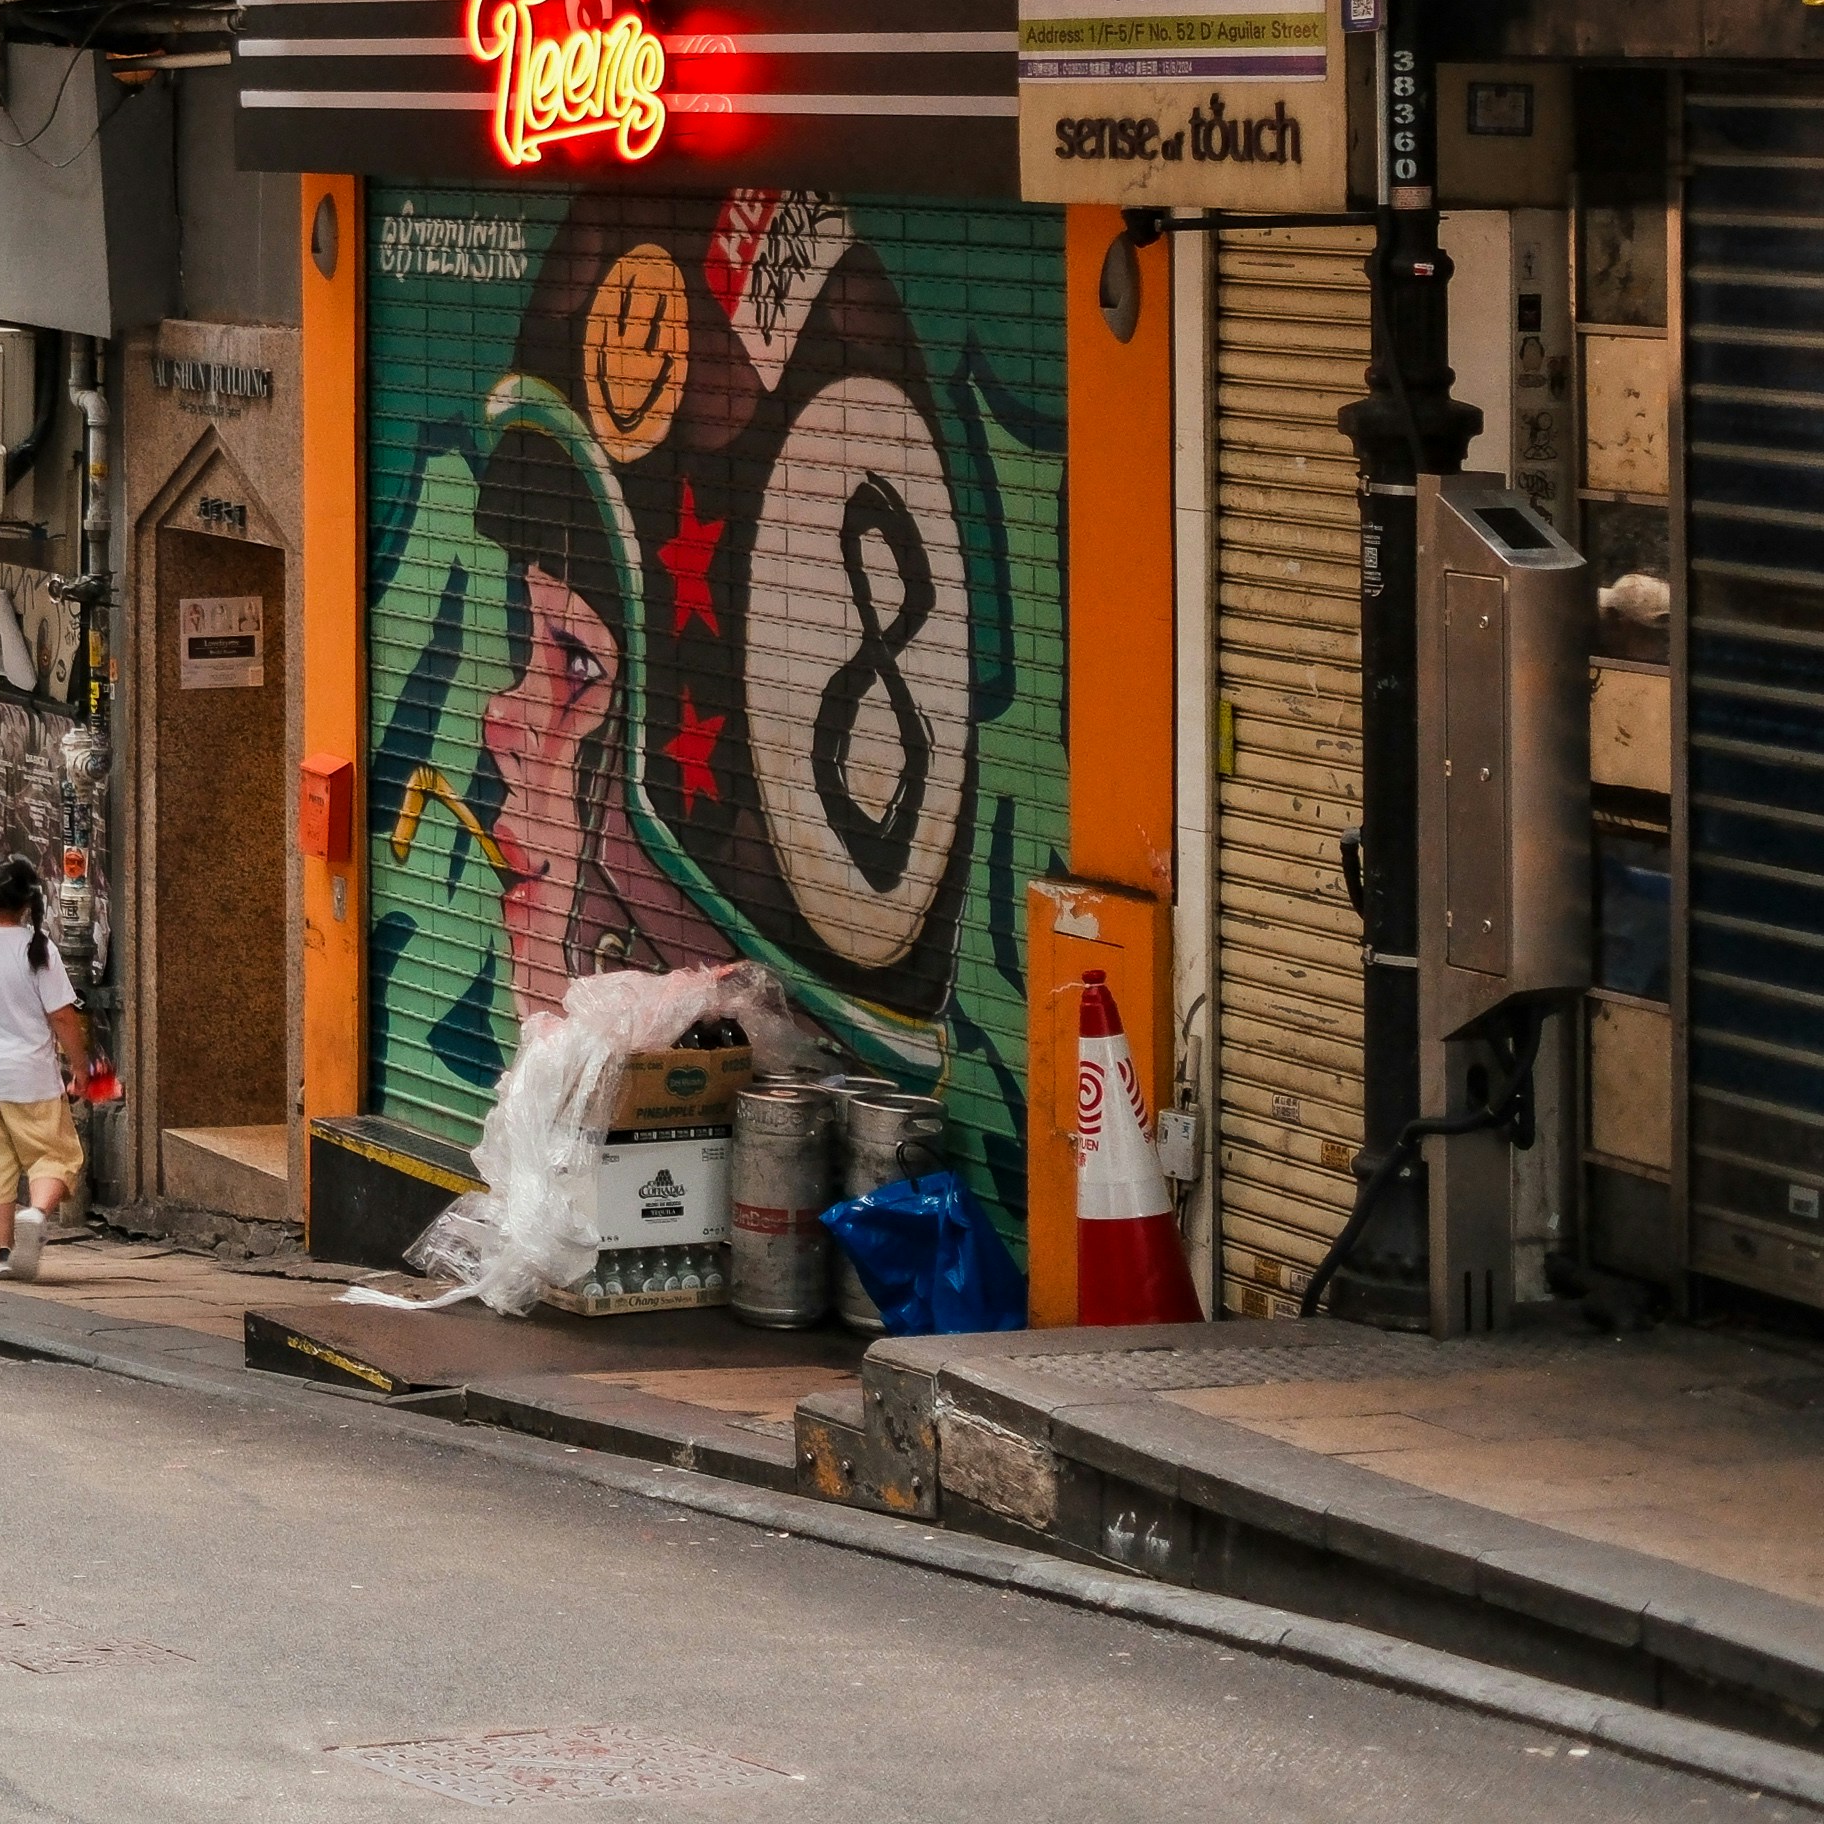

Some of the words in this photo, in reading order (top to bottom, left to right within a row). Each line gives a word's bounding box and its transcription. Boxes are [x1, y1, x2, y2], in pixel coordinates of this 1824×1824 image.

[1025, 25, 1085, 45] Address:
[1088, 22, 1145, 45] 1/F-5/F
[1149, 22, 1174, 42] No.
[1176, 22, 1196, 41] 52
[1271, 19, 1320, 39] Street
[1392, 49, 1418, 180] 38360
[1054, 114, 1159, 164] sense
[1160, 131, 1186, 163] of
[1189, 91, 1304, 167] touch
[210, 362, 269, 399] BUILDING
[634, 1105, 696, 1120] PINEAPPLE
[650, 1208, 677, 1217] TEQUILA
[628, 1294, 660, 1309] Chang
